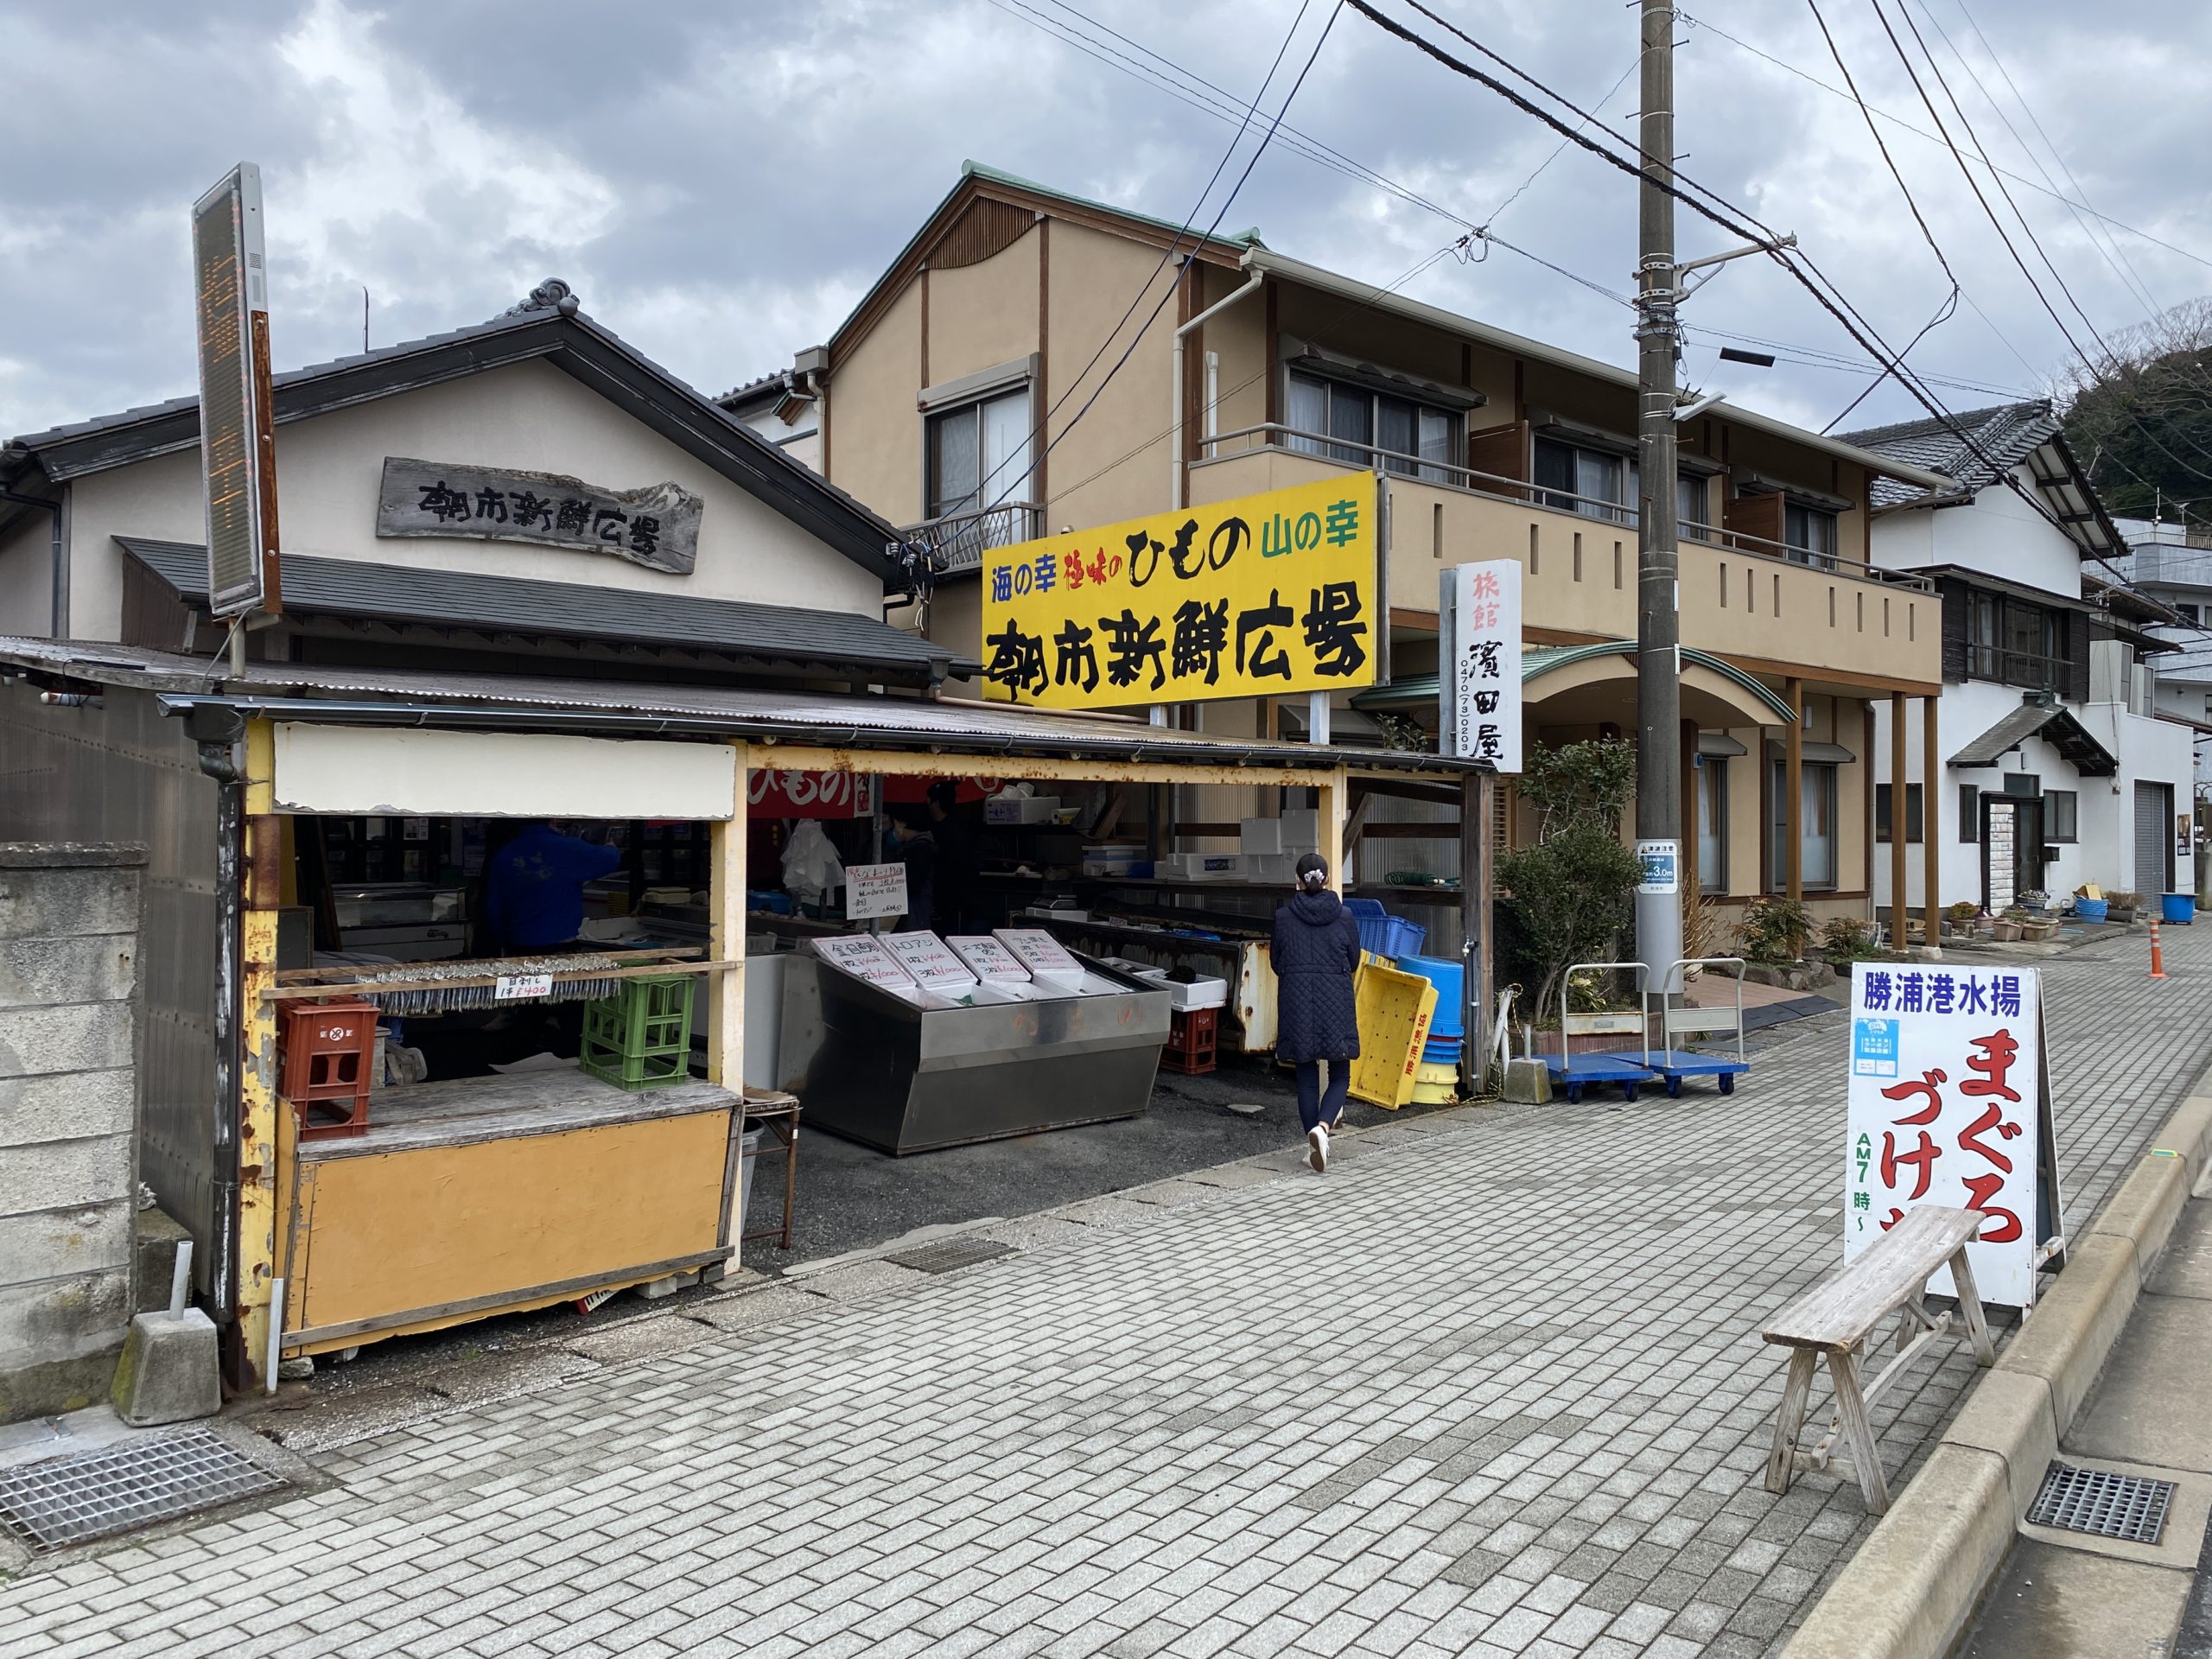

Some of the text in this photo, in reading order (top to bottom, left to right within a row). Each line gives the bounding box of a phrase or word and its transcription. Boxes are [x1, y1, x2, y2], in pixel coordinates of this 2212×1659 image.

[419, 480, 660, 555] 朝市新鮮広場
[991, 553, 1057, 603] 海の幸
[1126, 516, 1251, 588] ひもの
[1262, 499, 1359, 558] 山の幸
[986, 581, 1368, 702] 朝市新鮮広場
[1472, 570, 1500, 631] 旅館
[1459, 659, 1471, 752] 0470(73)0203
[1468, 639, 1504, 760] 濱田屋
[1864, 971, 2022, 1018] 勝浦港水揚
[1879, 1068, 1948, 1232] づけ
[1957, 1028, 2023, 1243] まぐろ
